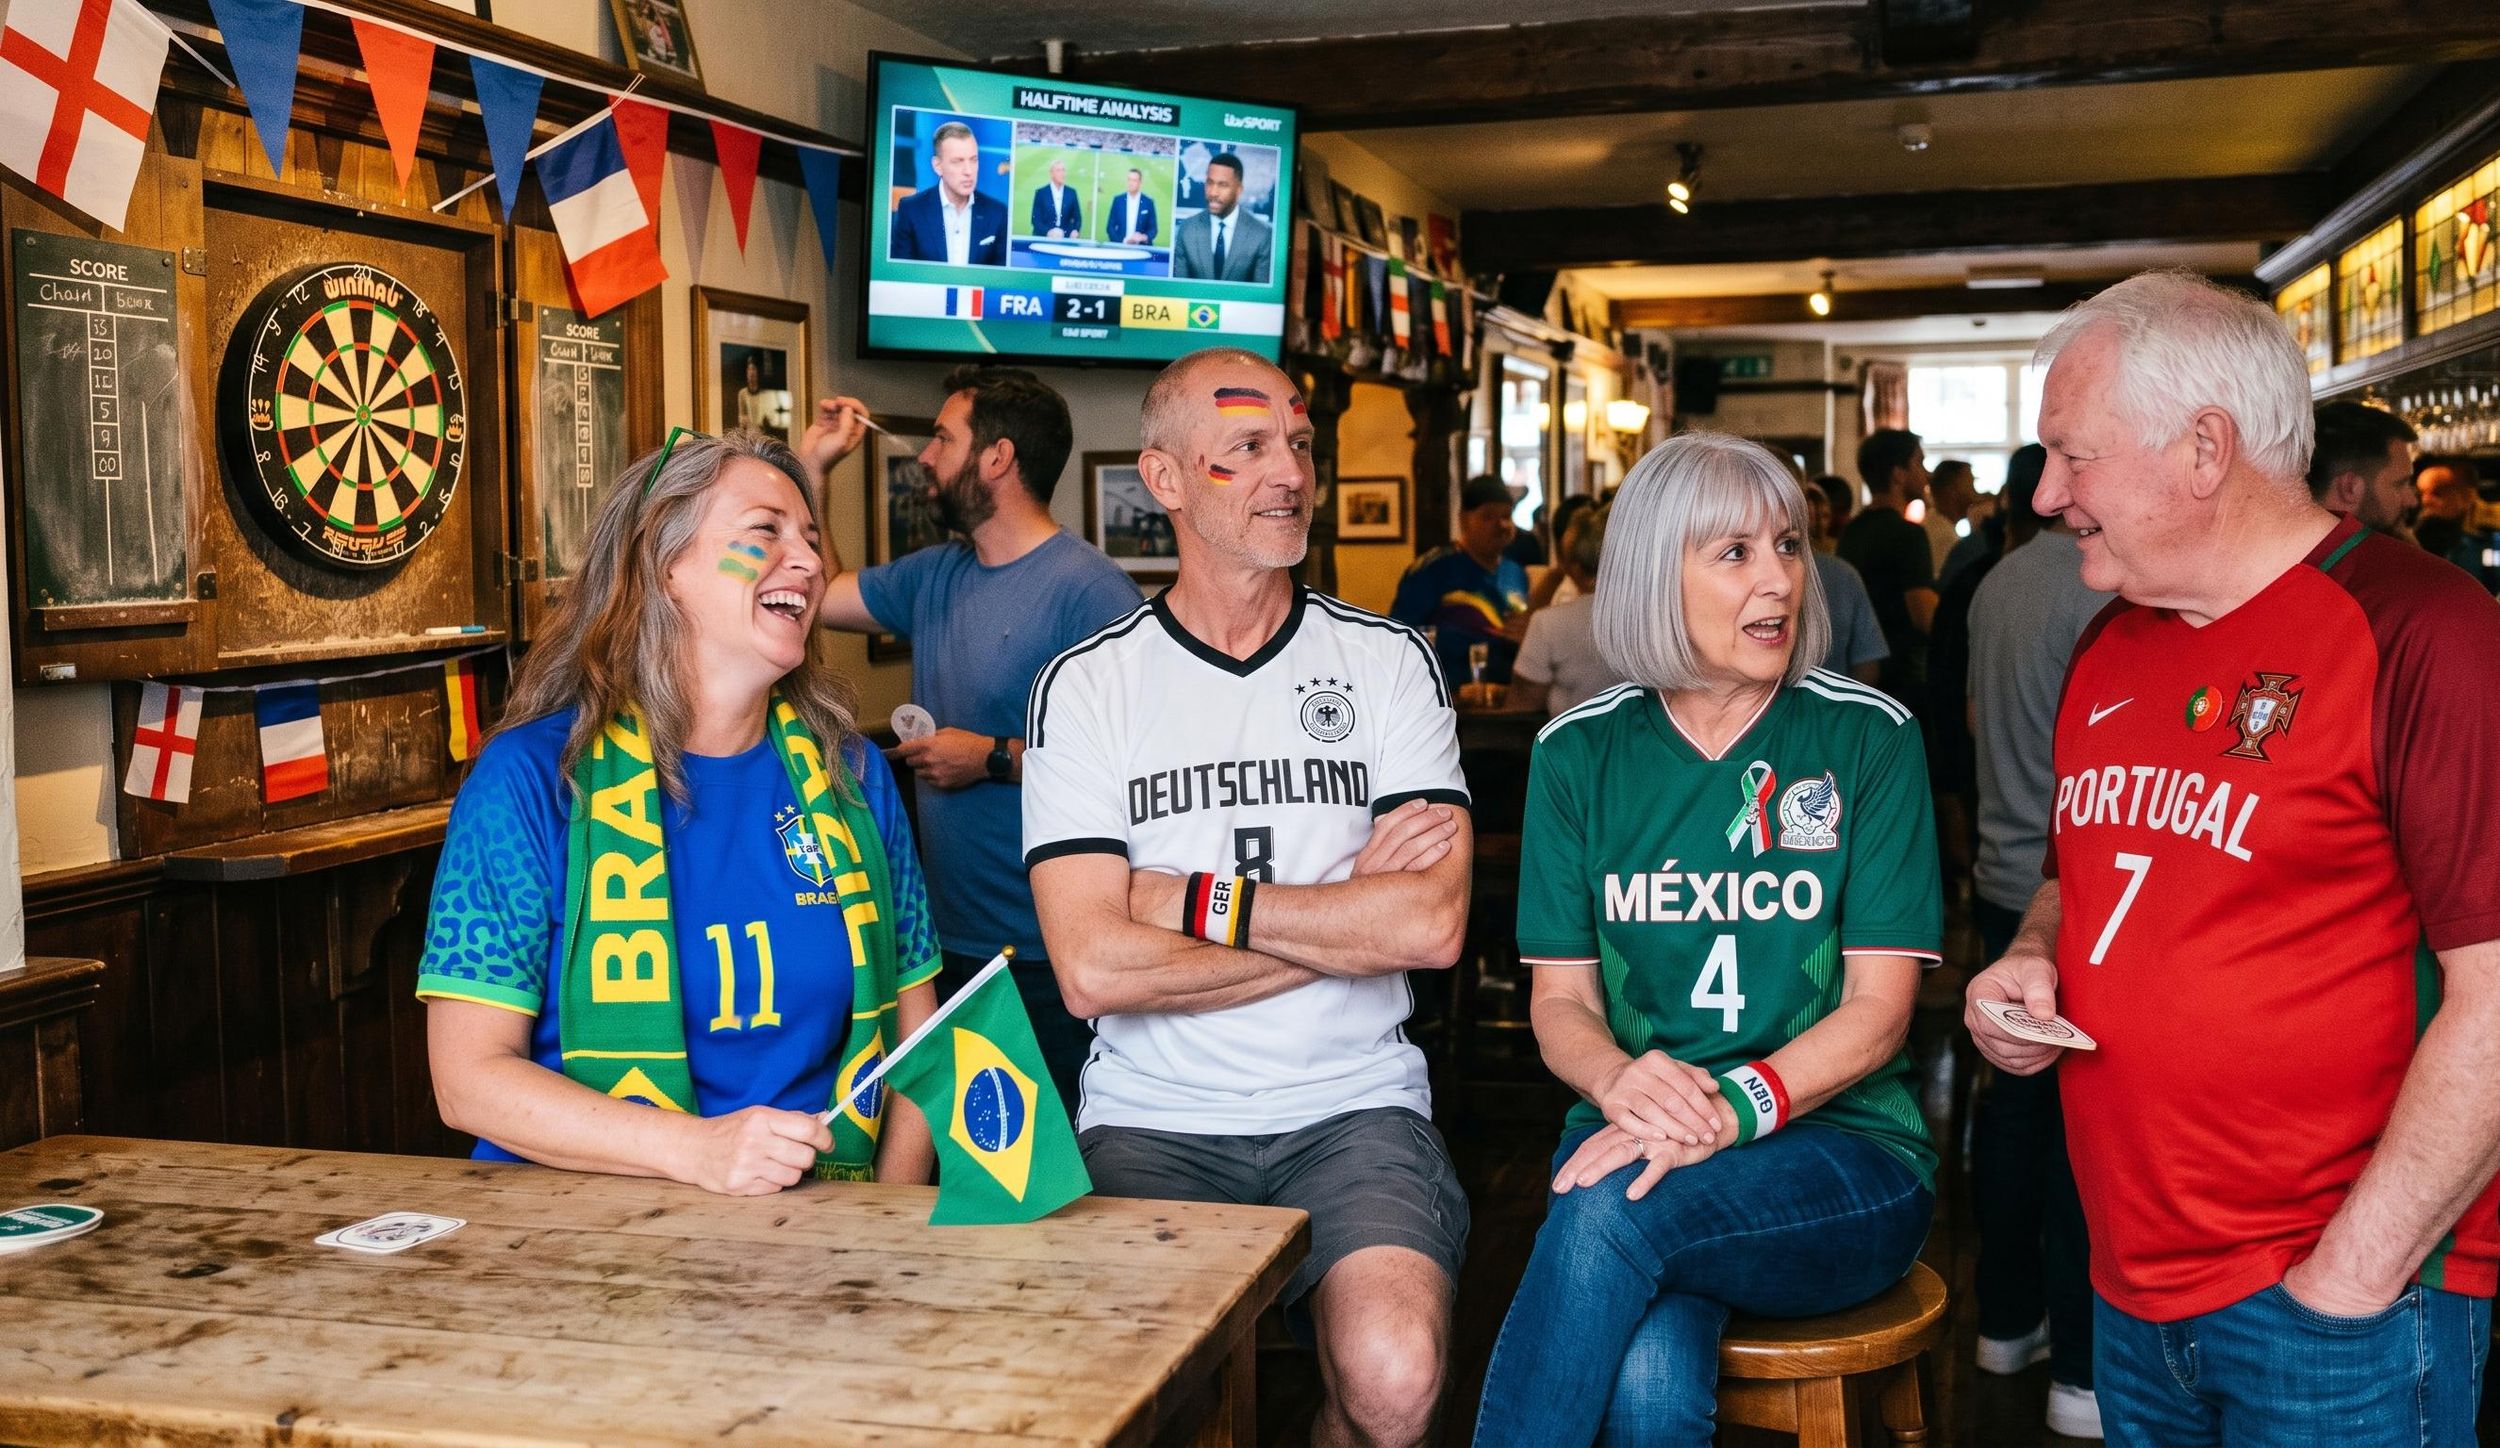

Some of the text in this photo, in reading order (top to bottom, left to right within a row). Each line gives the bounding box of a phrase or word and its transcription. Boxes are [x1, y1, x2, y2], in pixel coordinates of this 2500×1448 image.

[1020, 91, 1173, 123] HALFTIME ANALYSIS
[70, 258, 129, 281] SCORE
[1000, 295, 1043, 316] FRA
[1132, 303, 1171, 322] BRA
[566, 323, 600, 341] SCORE
[93, 348, 113, 361] 20
[100, 401, 111, 419] 5
[1128, 758, 1370, 826] DEUTSCHLAND
[2055, 765, 2260, 863] PORTUGAL
[1234, 826, 1275, 884] 8
[1212, 881, 1232, 915] GER
[1604, 859, 1823, 922] MÉXICO
[2088, 851, 2153, 966] 7
[706, 920, 782, 1033] 11
[1690, 934, 1746, 1033] 4
